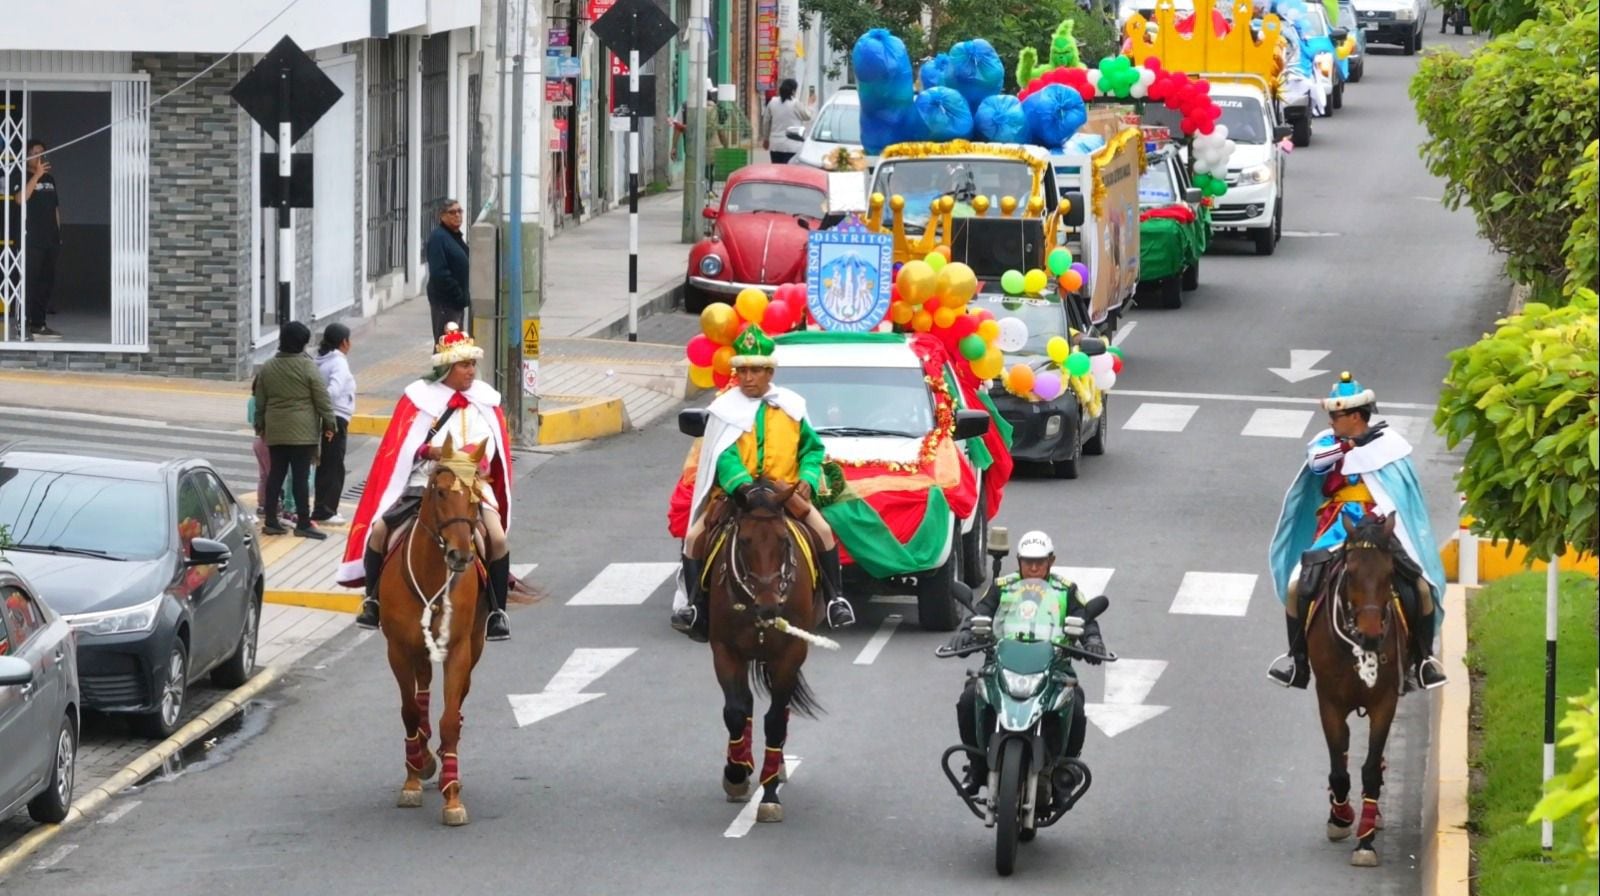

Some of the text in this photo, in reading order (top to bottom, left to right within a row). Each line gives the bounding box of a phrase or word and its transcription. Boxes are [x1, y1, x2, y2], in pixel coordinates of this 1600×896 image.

[815, 232, 886, 244] DISTRITO
[808, 242, 819, 272] JOSE
[880, 246, 892, 294] RIVERO
[808, 276, 819, 305] LUIS
[812, 306, 886, 332] BUSTAMANTE
[1021, 538, 1046, 547] POLICIA
